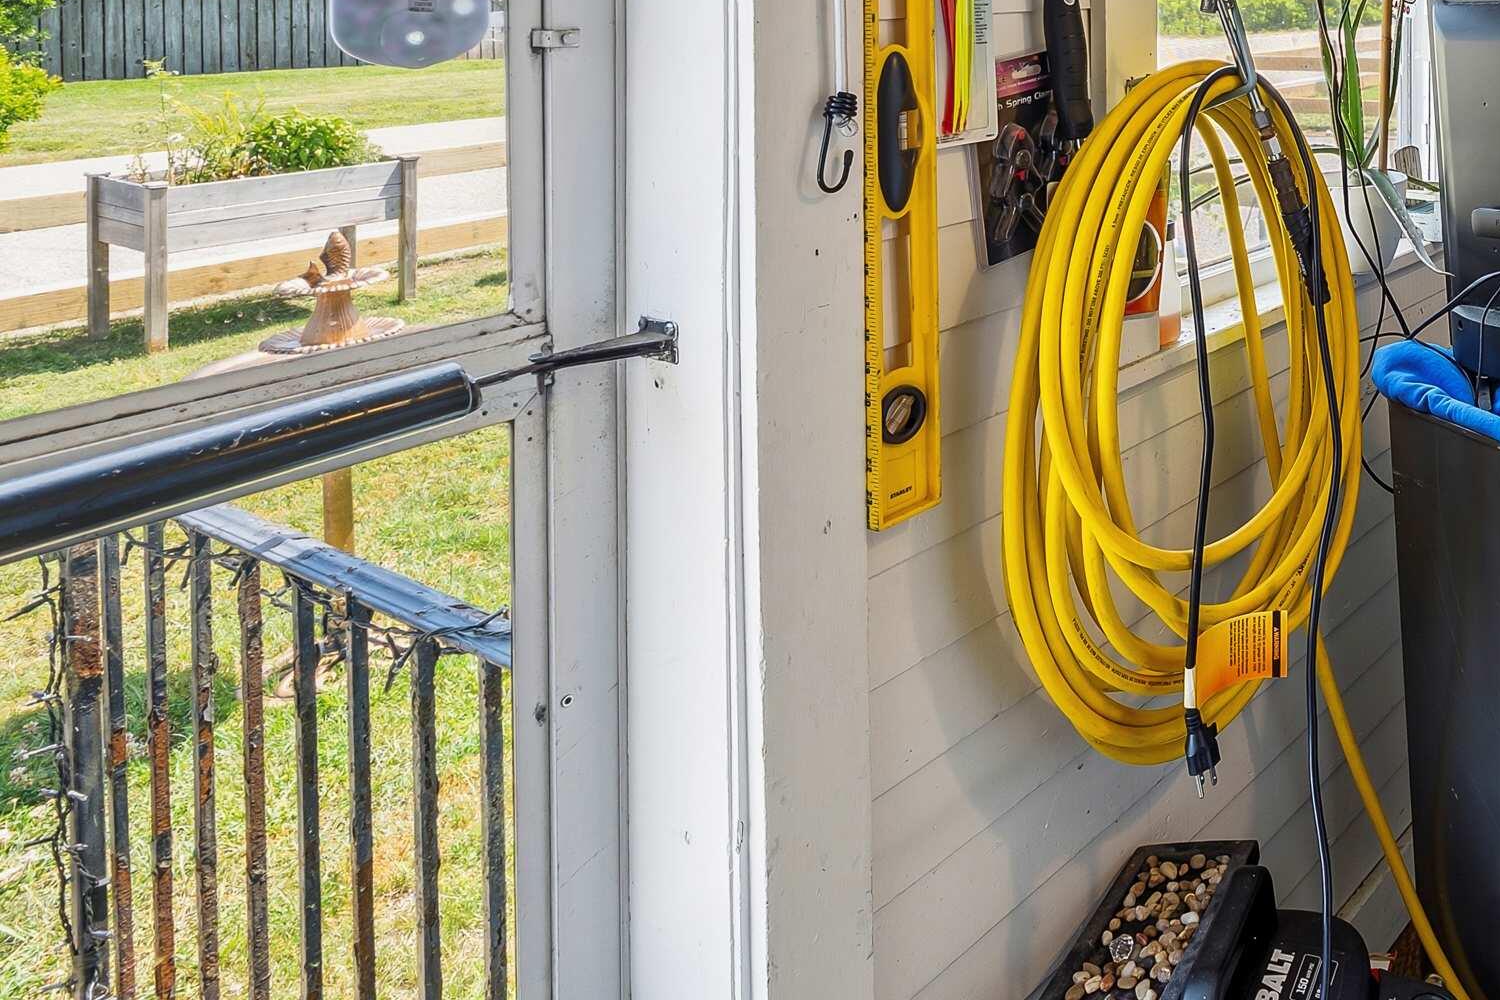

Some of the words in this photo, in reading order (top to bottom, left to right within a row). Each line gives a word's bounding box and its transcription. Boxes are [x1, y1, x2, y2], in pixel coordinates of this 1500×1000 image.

[1006, 95, 1032, 109] Spring
[890, 485, 912, 499] STANLEY
[1296, 978, 1309, 995] 150
